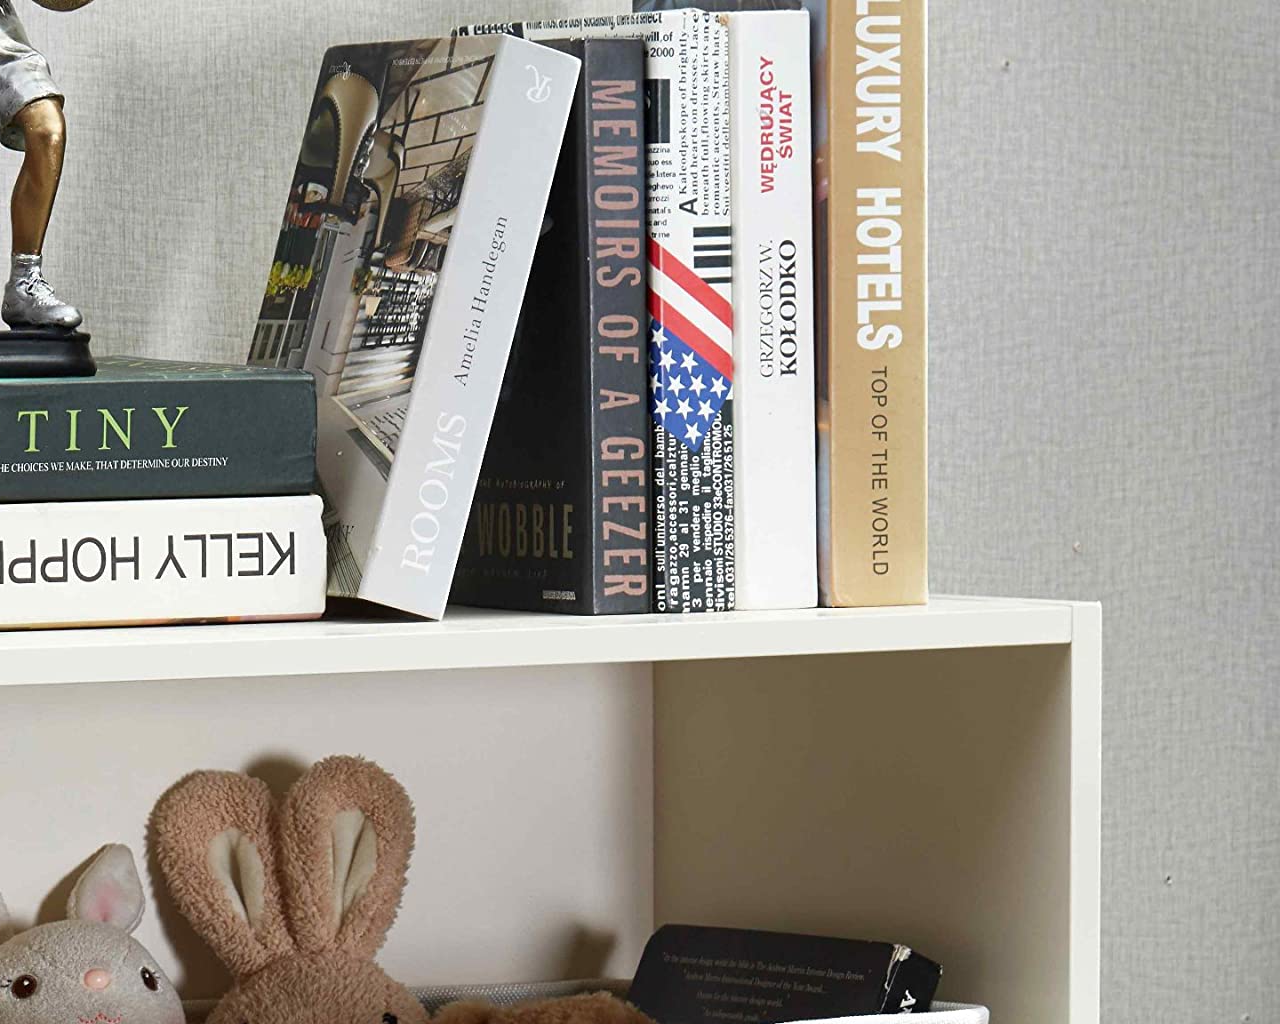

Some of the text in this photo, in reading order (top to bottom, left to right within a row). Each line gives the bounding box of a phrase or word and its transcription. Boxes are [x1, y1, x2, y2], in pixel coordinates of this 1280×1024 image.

[650, 46, 675, 61] 2000
[700, 45, 710, 82] skirts
[711, 29, 721, 57] hats
[711, 61, 721, 99] Straw
[690, 108, 699, 125] on
[775, 90, 793, 159] ŚWIAT
[690, 127, 699, 168] hearts
[591, 78, 641, 288] MEMOIRS
[690, 172, 699, 196] and
[701, 165, 710, 216] beneath
[711, 156, 721, 216] romantic
[855, 0, 903, 351] LUXURY HOTELS
[454, 215, 508, 387] Amelia Handegan
[759, 267, 774, 378] GRZEGORZ
[778, 239, 798, 377] KOŁODKO
[597, 314, 639, 363] OF
[599, 388, 640, 410] A
[654, 421, 665, 458] bamb
[11, 462, 49, 473] CHOICES
[51, 462, 65, 472] WE
[66, 461, 94, 472] MAKE,
[95, 460, 119, 470] THAT
[120, 459, 170, 469] DETERMINE
[171, 458, 190, 468] OUR
[192, 457, 229, 467] DESTINY
[655, 468, 665, 486] del
[690, 455, 702, 496] meglio
[871, 366, 889, 577] TOP OF THE WORLD
[400, 410, 467, 575] ROOMS
[678, 500, 689, 514] 31
[477, 502, 575, 560] WOBBLE
[600, 437, 648, 598] GEEZER
[678, 523, 689, 534] al
[690, 505, 701, 553] vendere
[701, 501, 714, 551] rispedire
[713, 511, 724, 556] STUDIO
[155, 531, 297, 578] KELLY
[678, 543, 689, 558] 29
[692, 561, 704, 584] per
